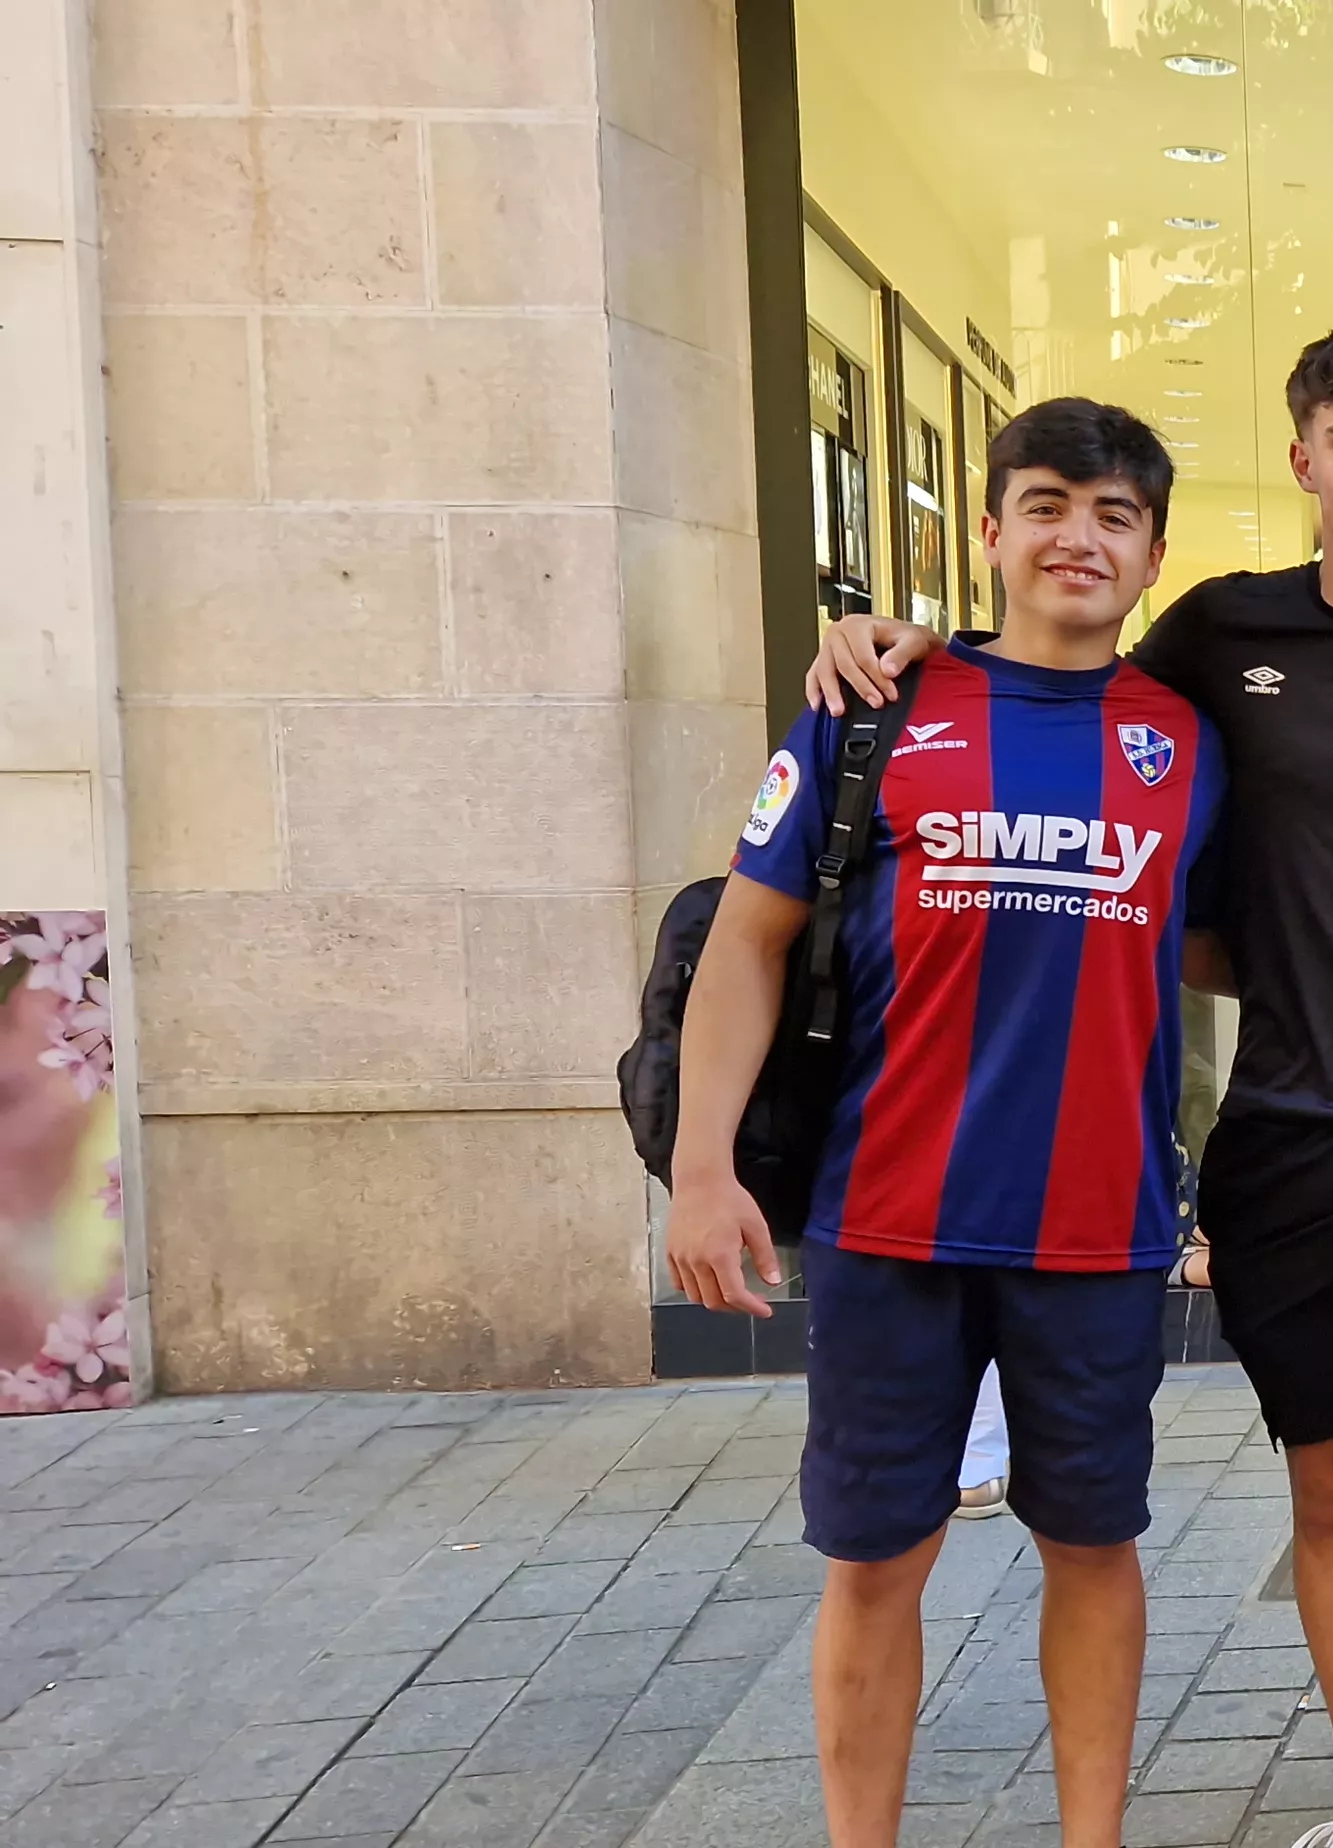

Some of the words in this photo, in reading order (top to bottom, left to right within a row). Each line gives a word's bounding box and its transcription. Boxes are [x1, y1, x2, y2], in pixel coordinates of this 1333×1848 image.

[808, 354, 849, 420] HANEL
[1244, 684, 1281, 696] umbro
[917, 888, 1149, 926] supermercados
